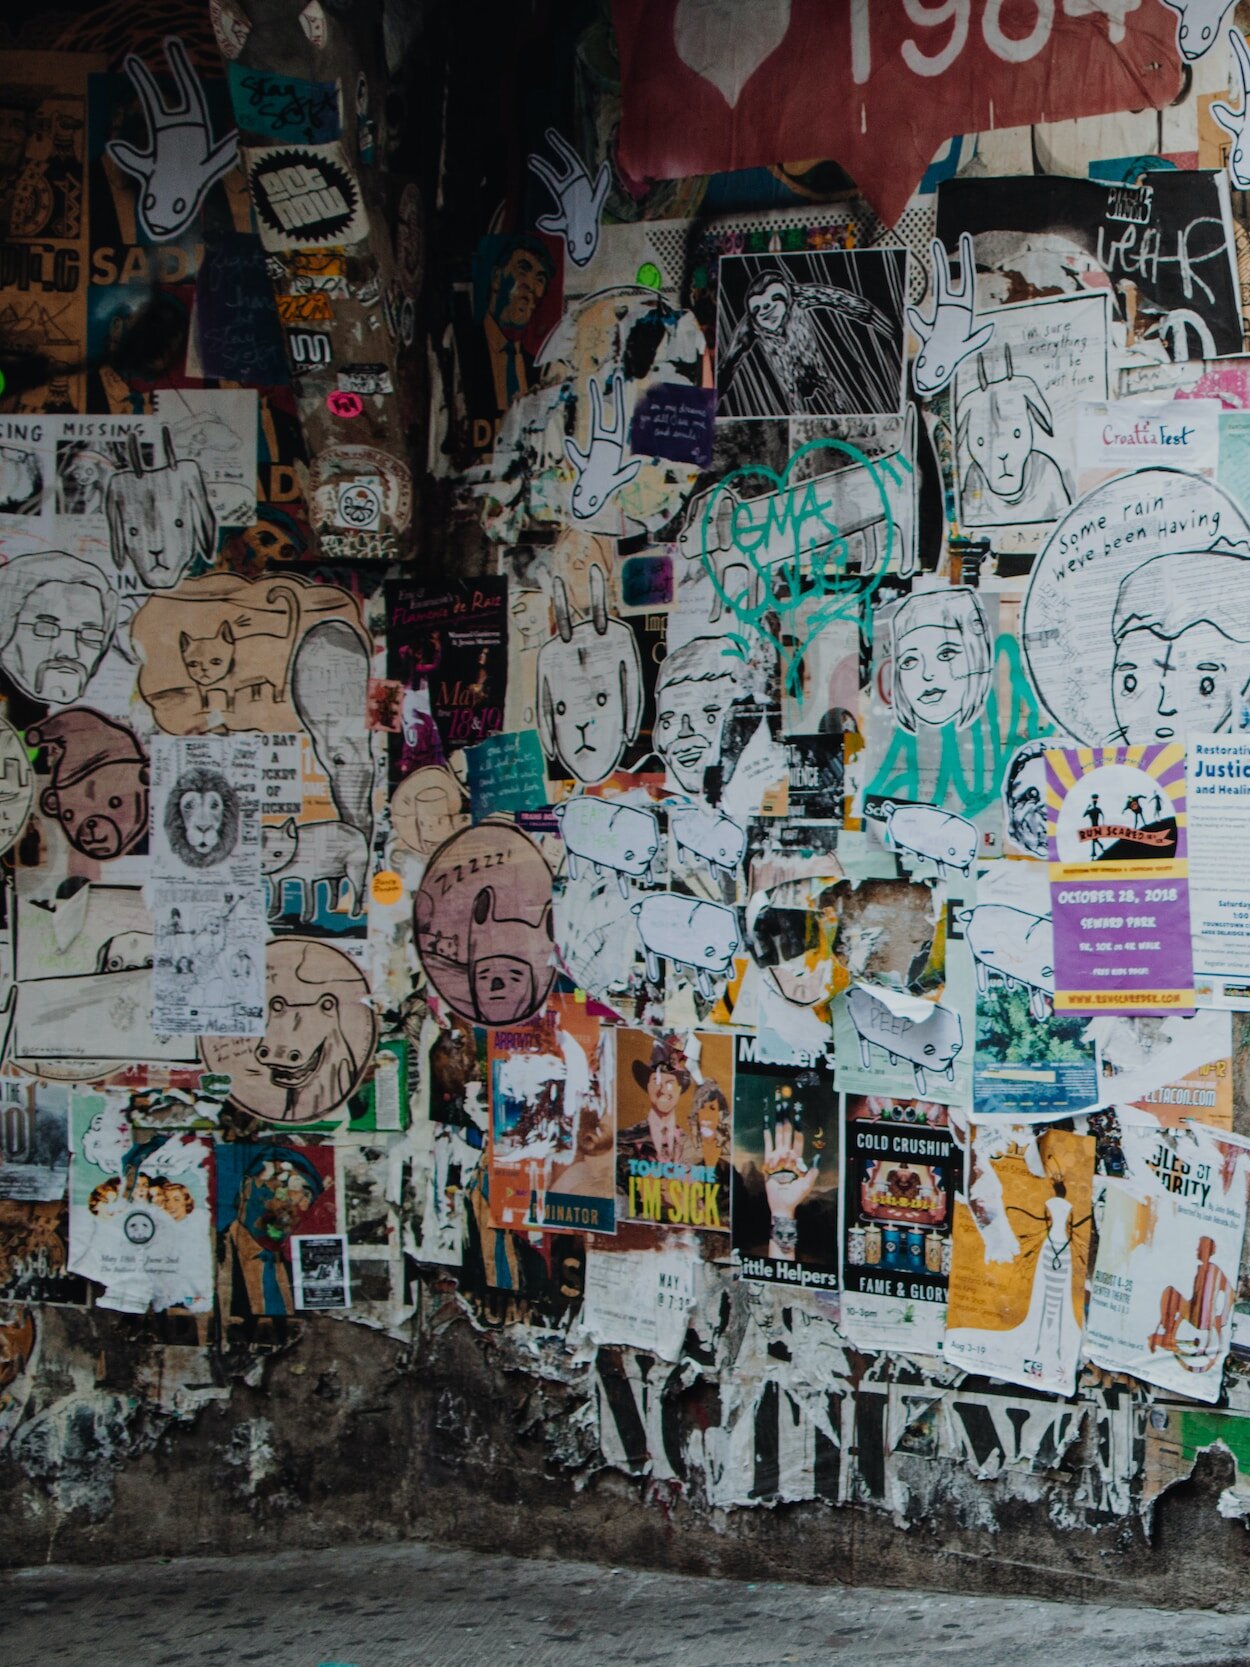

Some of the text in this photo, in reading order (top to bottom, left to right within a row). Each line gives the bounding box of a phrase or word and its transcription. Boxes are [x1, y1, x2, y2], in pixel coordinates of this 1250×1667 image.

[1044, 323, 1072, 340] sure
[1028, 335, 1087, 356] everything
[63, 423, 145, 437] MISSING
[1058, 494, 1165, 555] Some rain
[1103, 527, 1148, 558] been
[272, 735, 297, 747] EAT
[271, 752, 280, 763] A
[262, 768, 297, 781] CKET
[266, 785, 282, 797] OF
[1195, 784, 1216, 795] and
[1079, 826, 1144, 840] RUN SCARED
[1057, 888, 1179, 904] OCTOBER 28, 2018
[1080, 916, 1157, 930] SEWARD PARK
[870, 1007, 913, 1039] PEEP
[856, 1133, 954, 1158] COLD CRUSHIN'
[628, 1158, 718, 1184] TOUCH ME
[628, 1176, 721, 1228] I'M SICK
[659, 1272, 680, 1290] MAY
[775, 1261, 837, 1288] Helpers
[859, 1276, 949, 1303] FAME & GLORY
[951, 1340, 966, 1353] Aug
